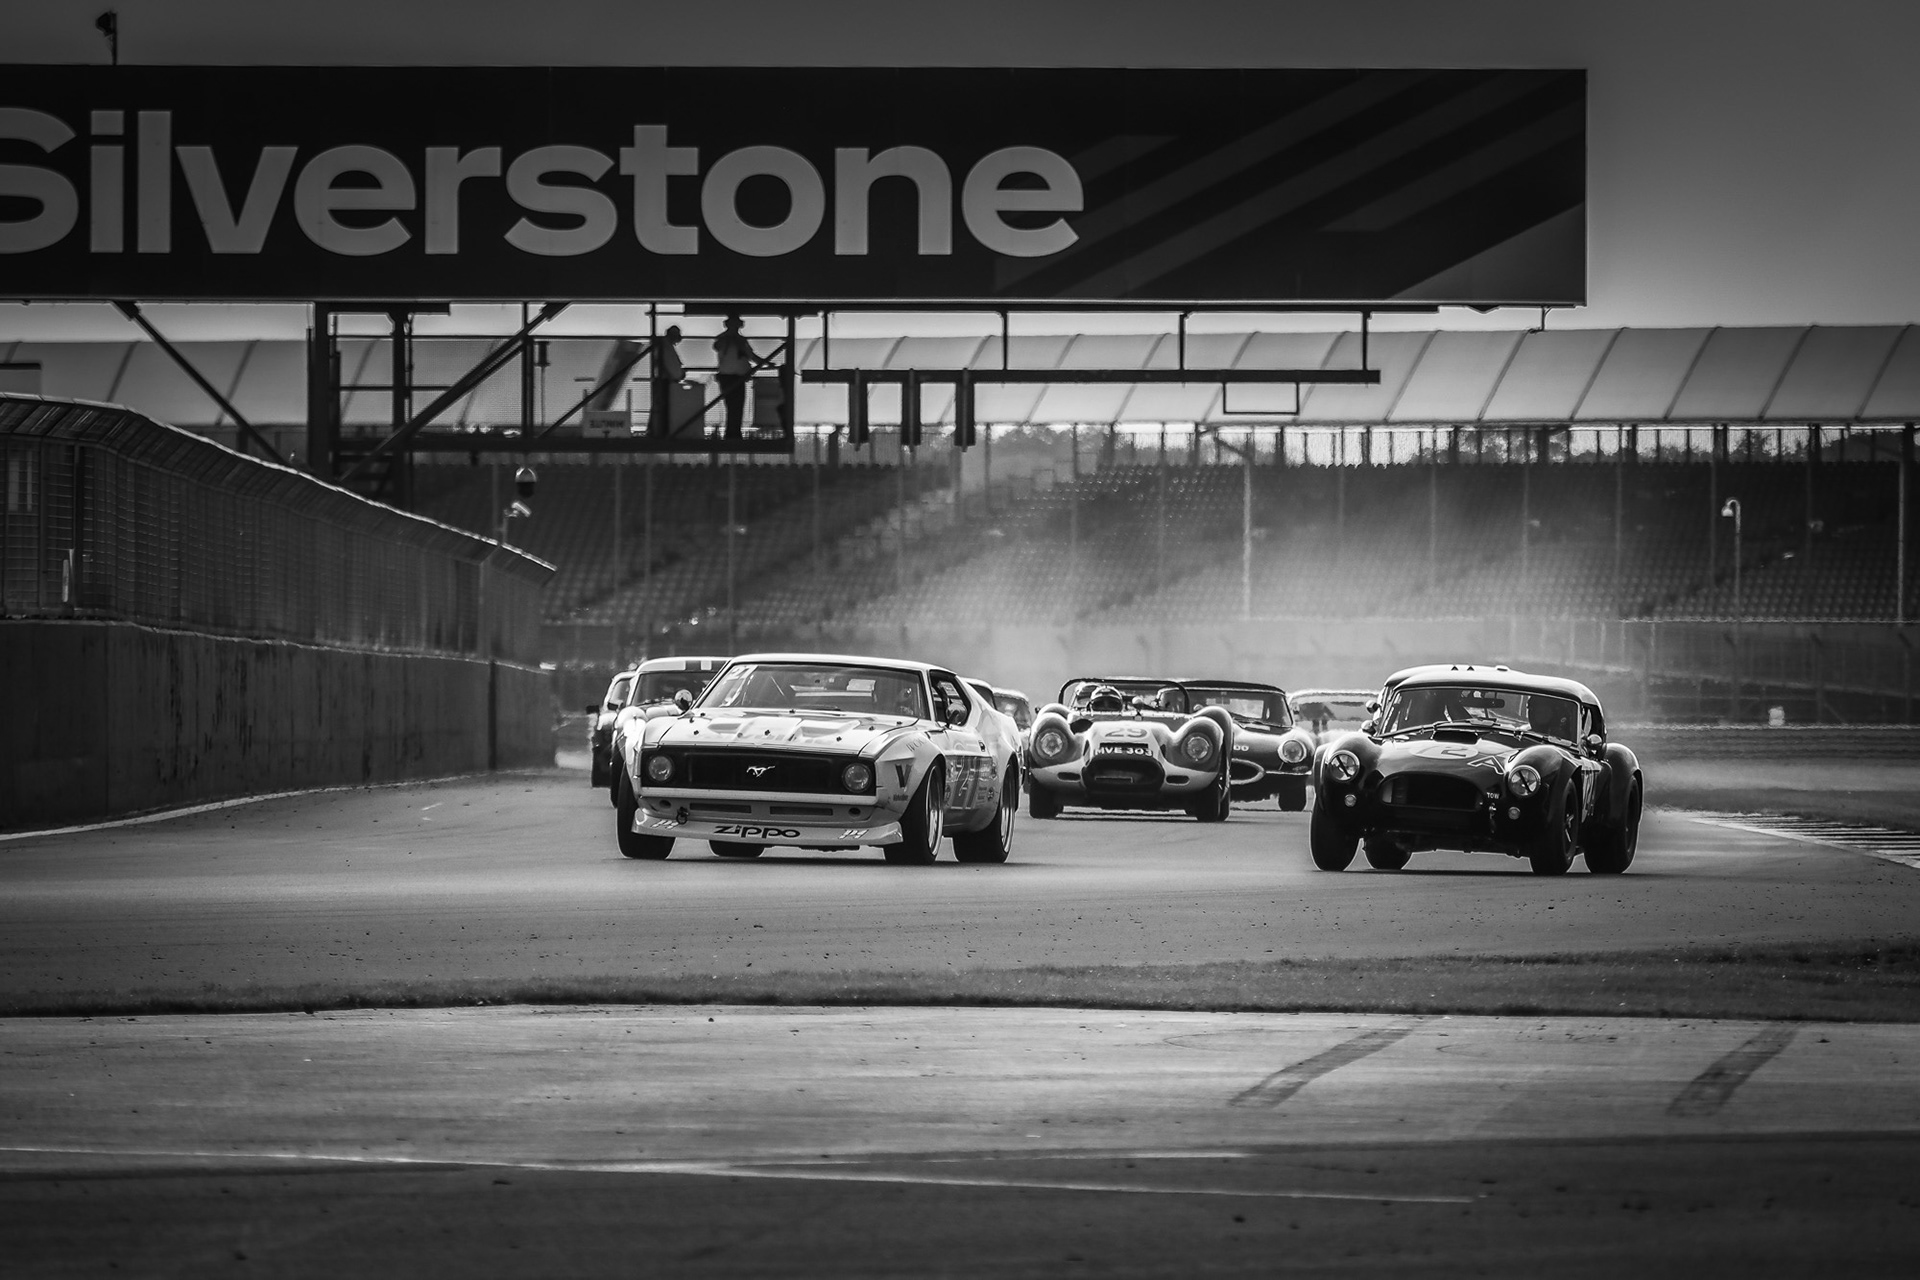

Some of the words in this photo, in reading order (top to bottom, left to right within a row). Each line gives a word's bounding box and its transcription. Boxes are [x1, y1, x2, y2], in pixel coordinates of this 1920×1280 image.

[0, 107, 1085, 257] Silverstone
[1105, 728, 1148, 738] 29
[1094, 746, 1123, 756] MVE
[1126, 746, 1153, 757] 303
[1486, 791, 1500, 800] TOW
[714, 824, 801, 839] zippo
